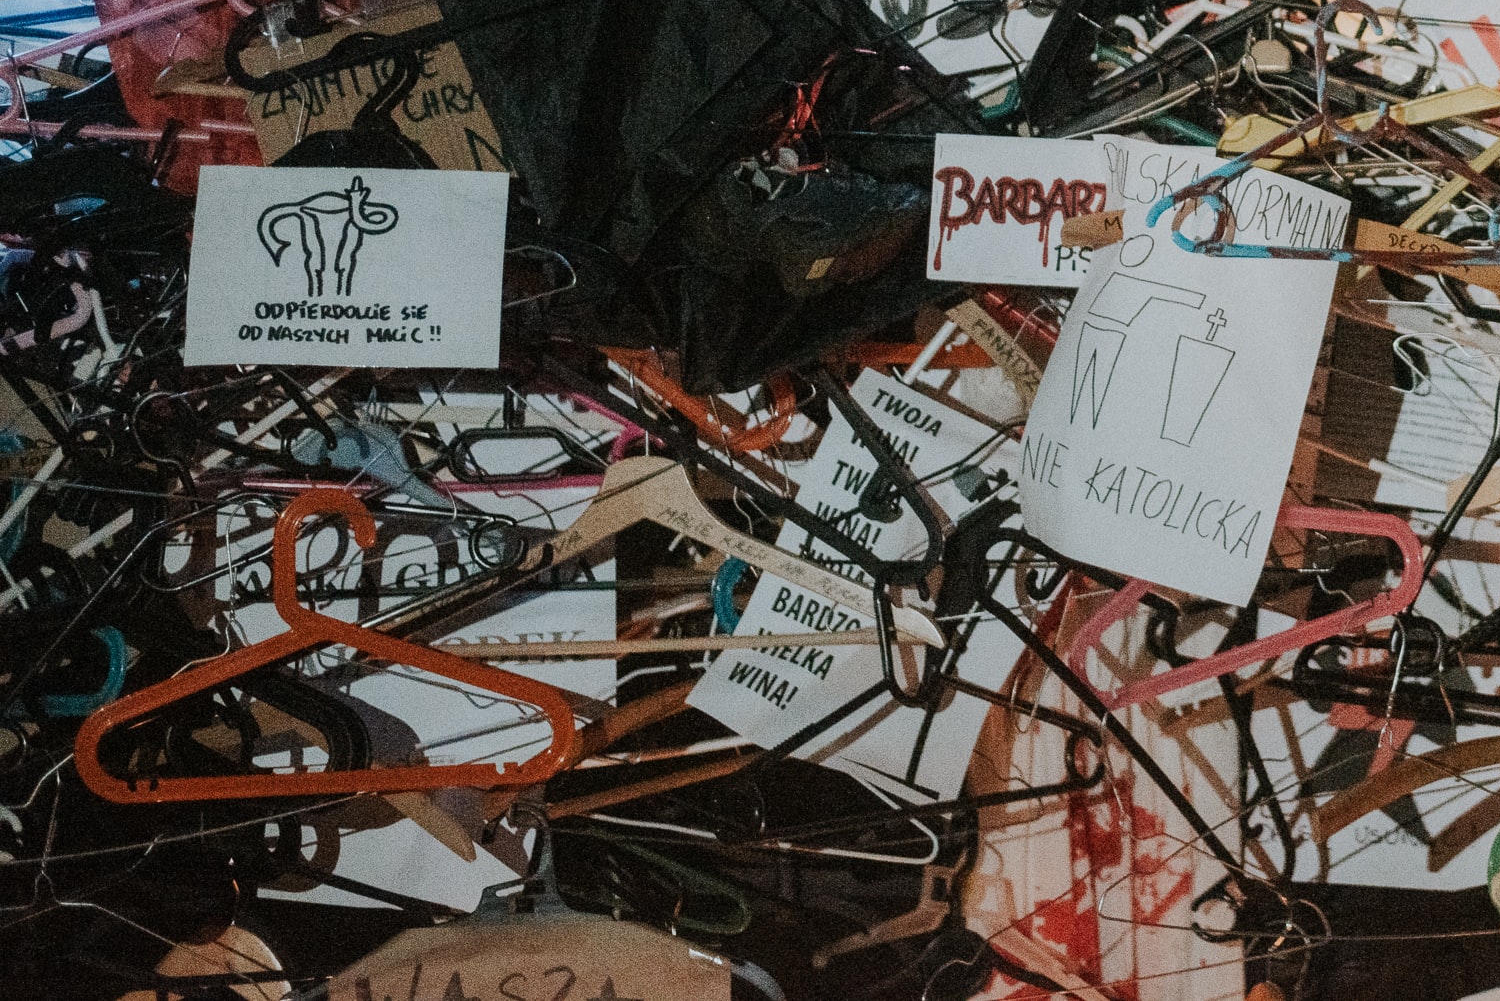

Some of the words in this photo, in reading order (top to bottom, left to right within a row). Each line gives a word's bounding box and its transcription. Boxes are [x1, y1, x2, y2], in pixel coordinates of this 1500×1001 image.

[238, 324, 263, 341] OD
[267, 324, 350, 344] NASZYCH
[870, 387, 945, 438] TWOJA
[1020, 432, 1063, 490] NIE
[1083, 458, 1265, 560] KATOLICKA
[727, 660, 800, 711] WINA!
